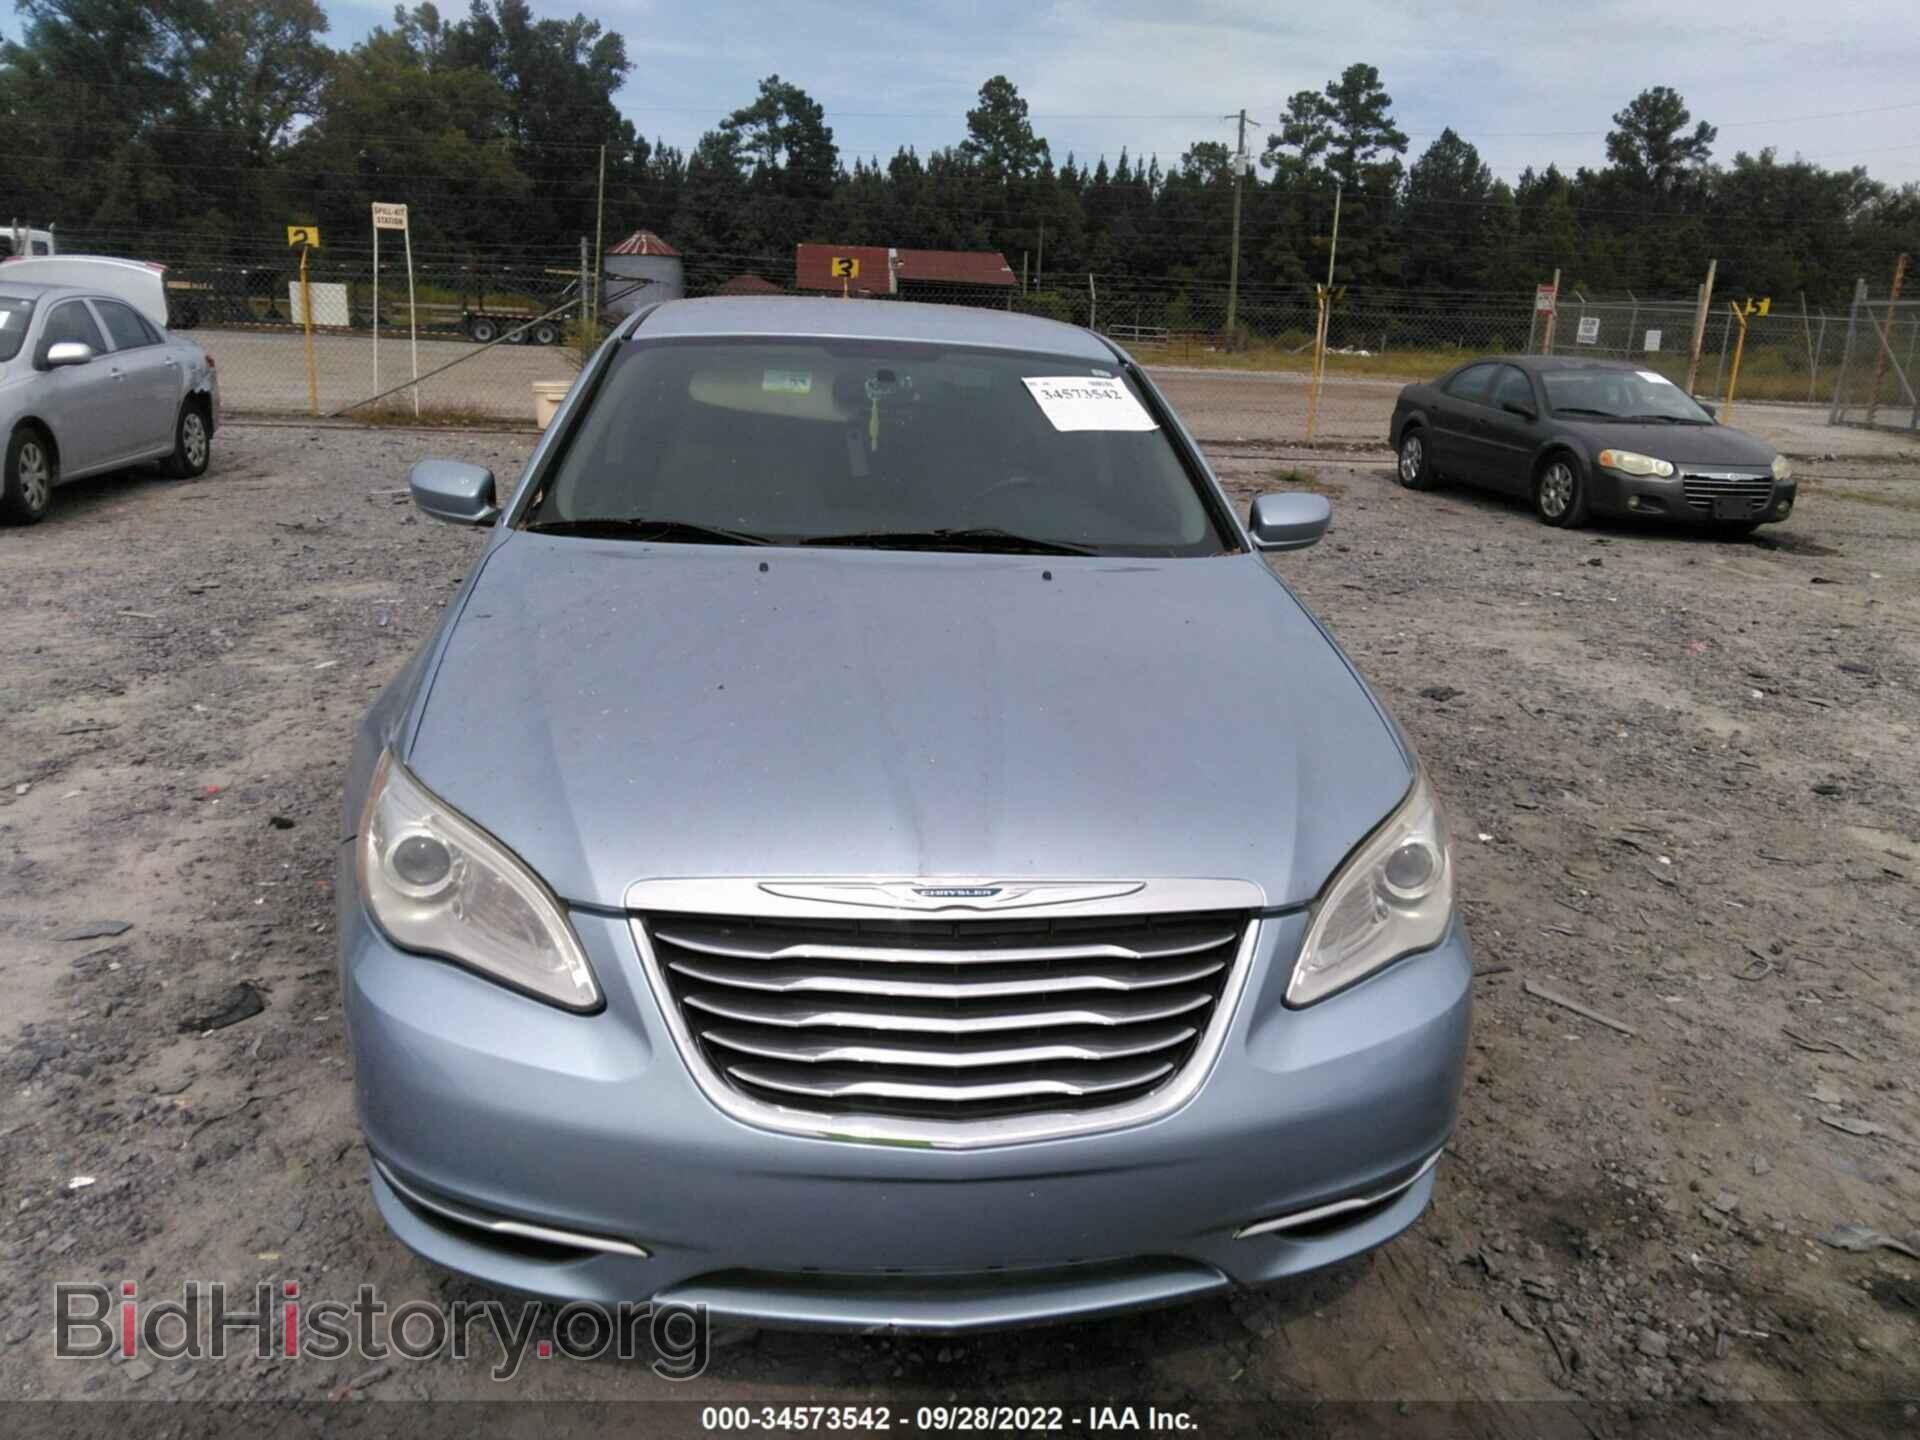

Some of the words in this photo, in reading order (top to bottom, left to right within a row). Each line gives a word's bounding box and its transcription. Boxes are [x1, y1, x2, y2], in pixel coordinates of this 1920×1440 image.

[376, 215, 404, 226] STATION
[838, 259, 853, 277] 3
[1040, 388, 1123, 400] 34573542
[920, 887, 992, 896] CHRYSLER
